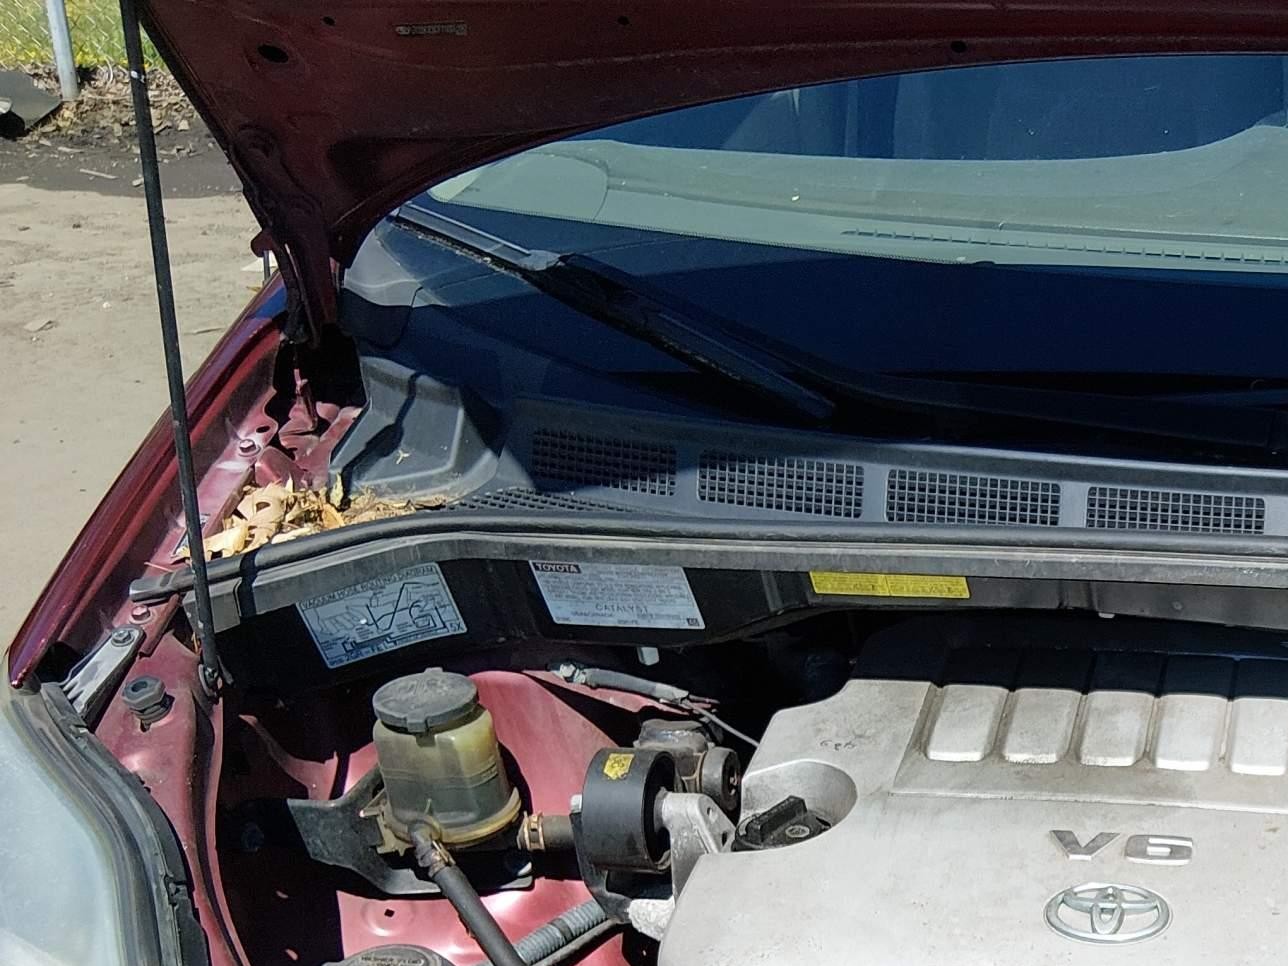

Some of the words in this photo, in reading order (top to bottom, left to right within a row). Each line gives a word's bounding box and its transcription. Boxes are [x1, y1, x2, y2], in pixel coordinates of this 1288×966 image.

[535, 563, 579, 573] TOYOTA
[595, 603, 649, 614] CATALYST
[1049, 829, 1194, 866] V6
